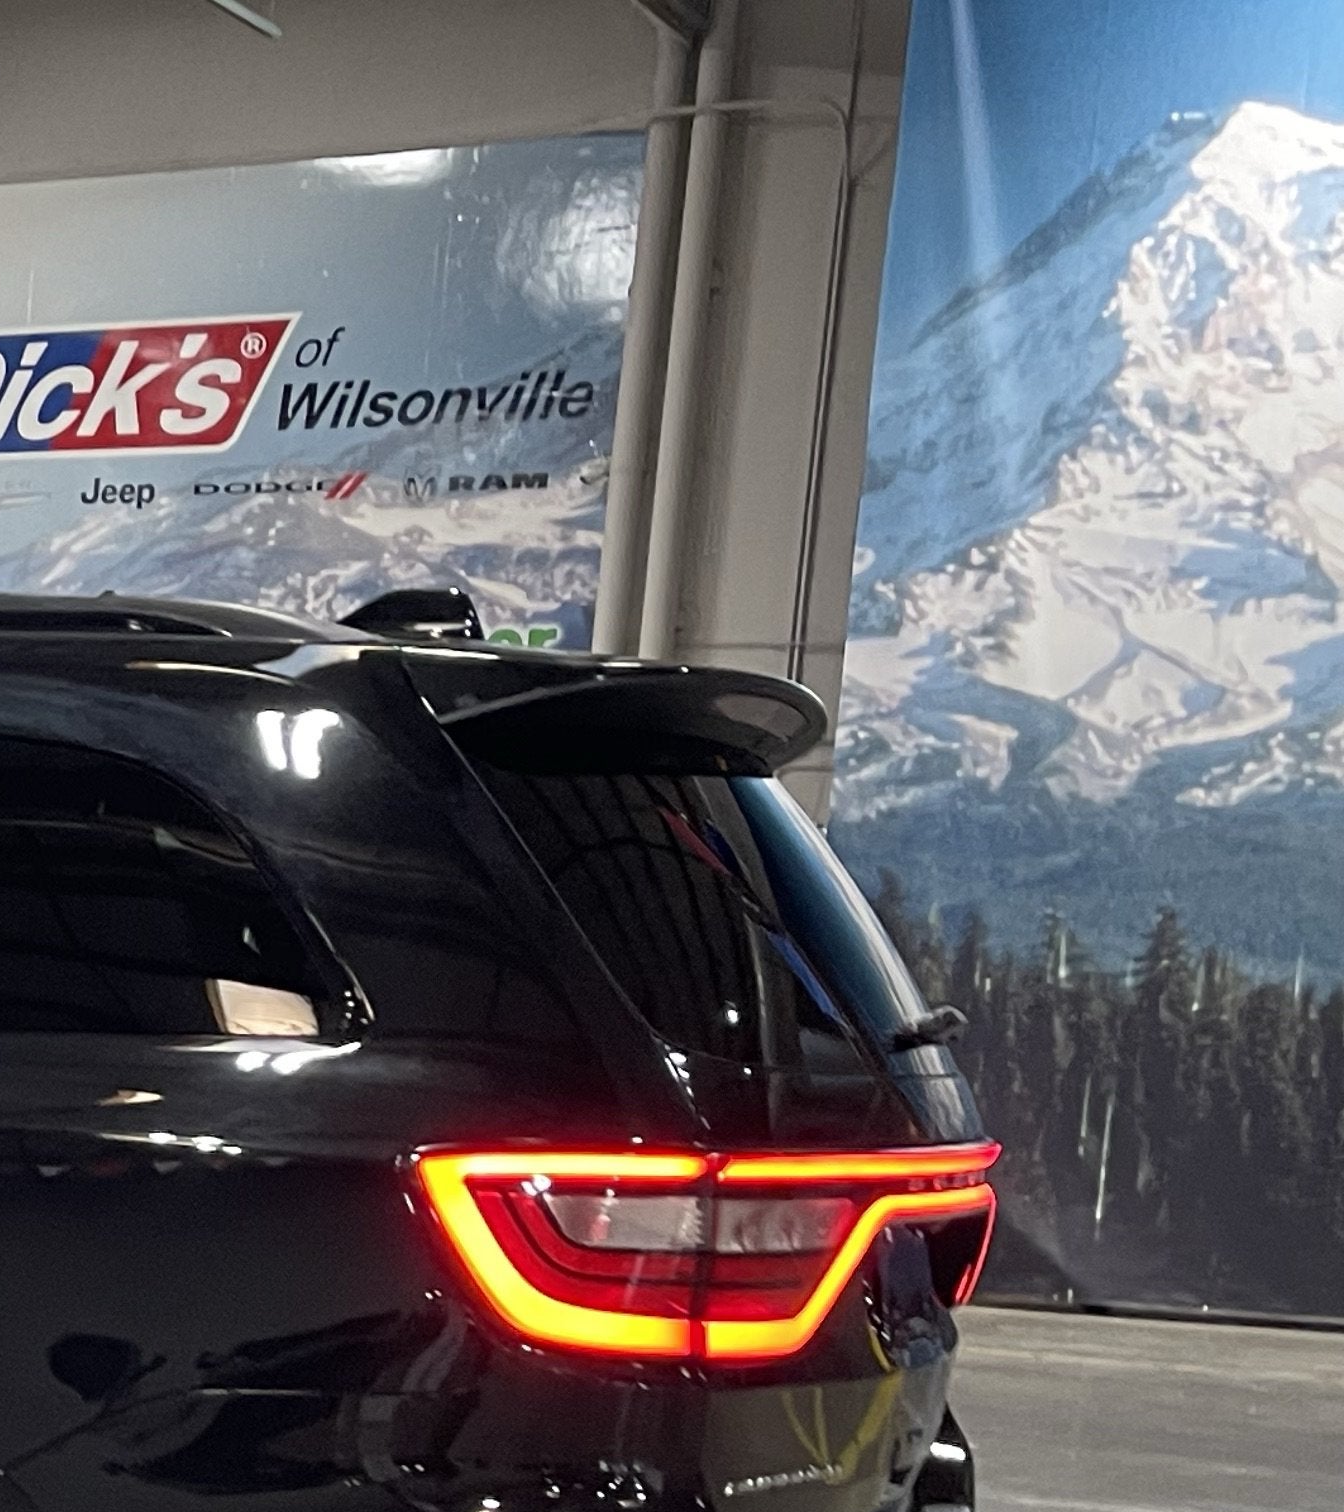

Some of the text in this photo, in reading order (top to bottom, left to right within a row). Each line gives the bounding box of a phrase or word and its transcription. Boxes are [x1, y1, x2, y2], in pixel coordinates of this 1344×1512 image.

[295, 326, 346, 369] of
[278, 369, 594, 430] Wilsonville
[81, 477, 155, 509] Jeep
[449, 472, 549, 491] RAM
